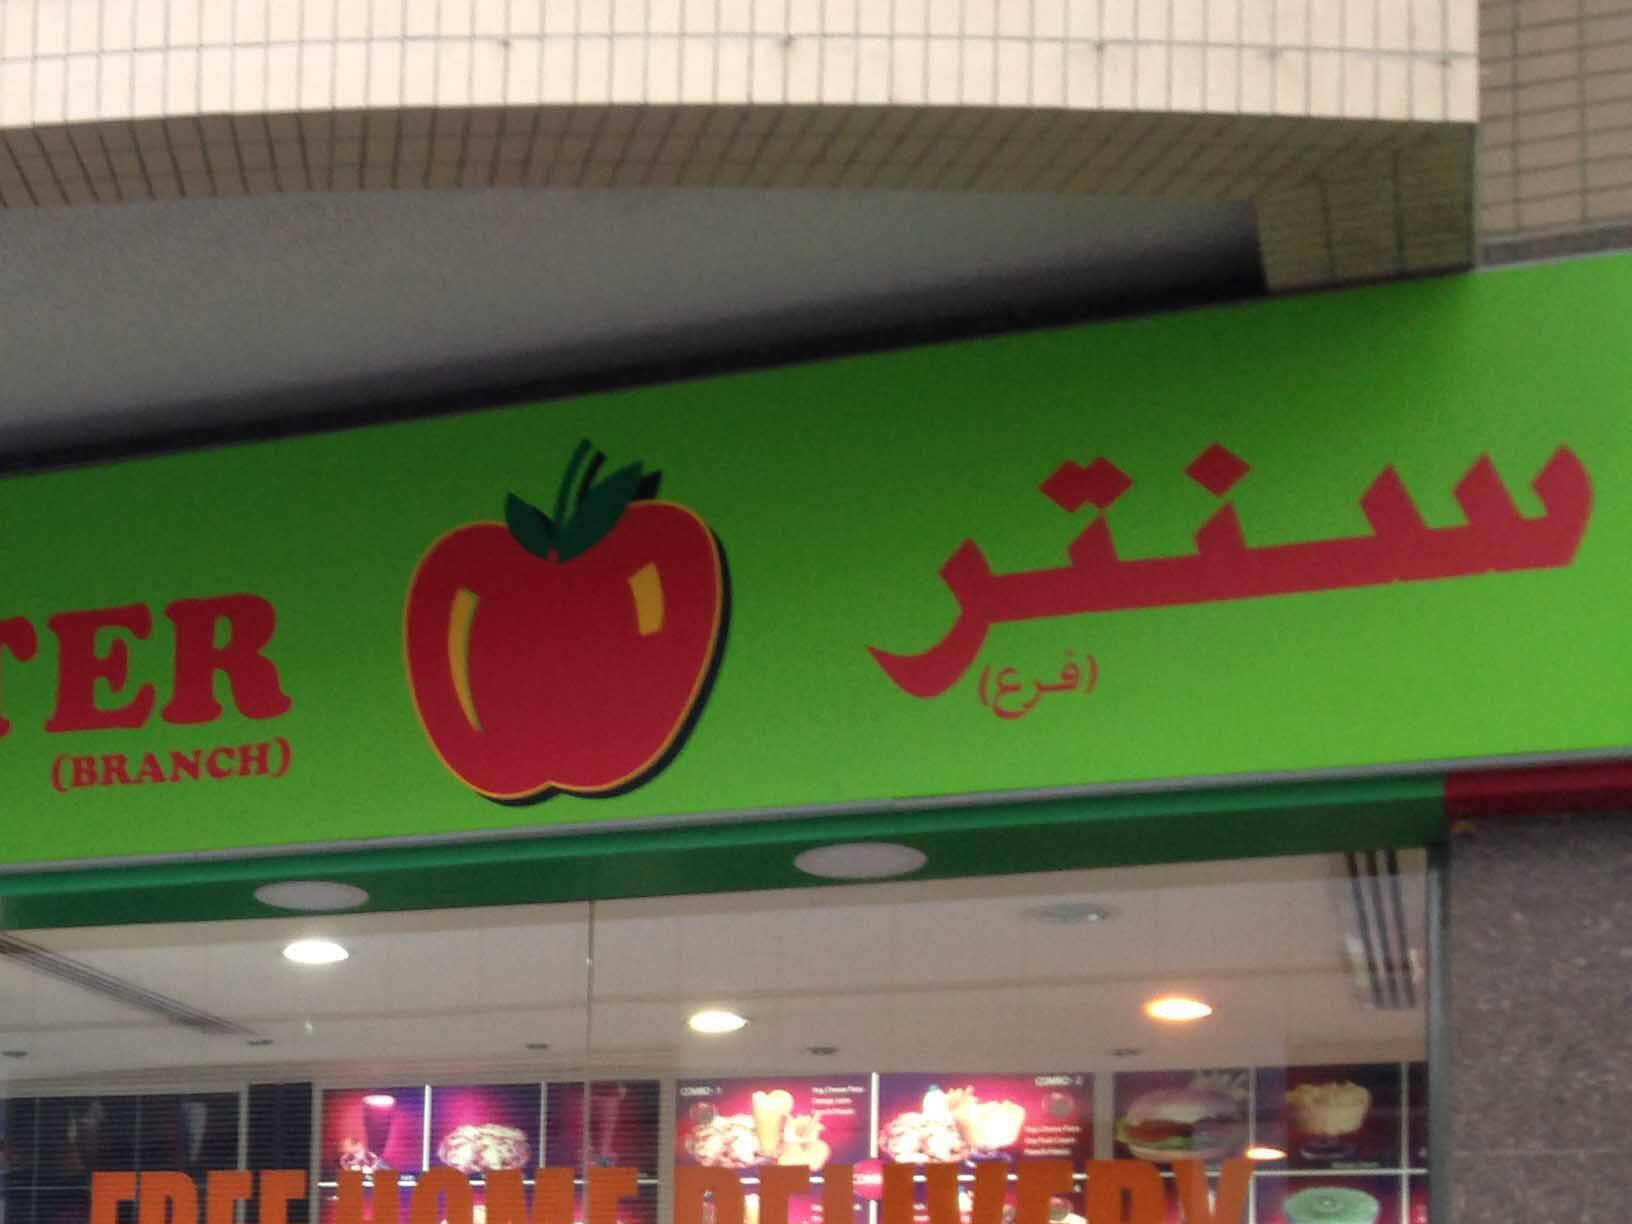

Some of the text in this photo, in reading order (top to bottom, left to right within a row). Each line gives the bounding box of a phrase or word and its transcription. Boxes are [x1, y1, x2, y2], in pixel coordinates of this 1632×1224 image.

[867, 443, 1594, 699] سنتر
[977, 650, 1099, 720] (فرع)
[51, 736, 292, 793] (BRANCH)
